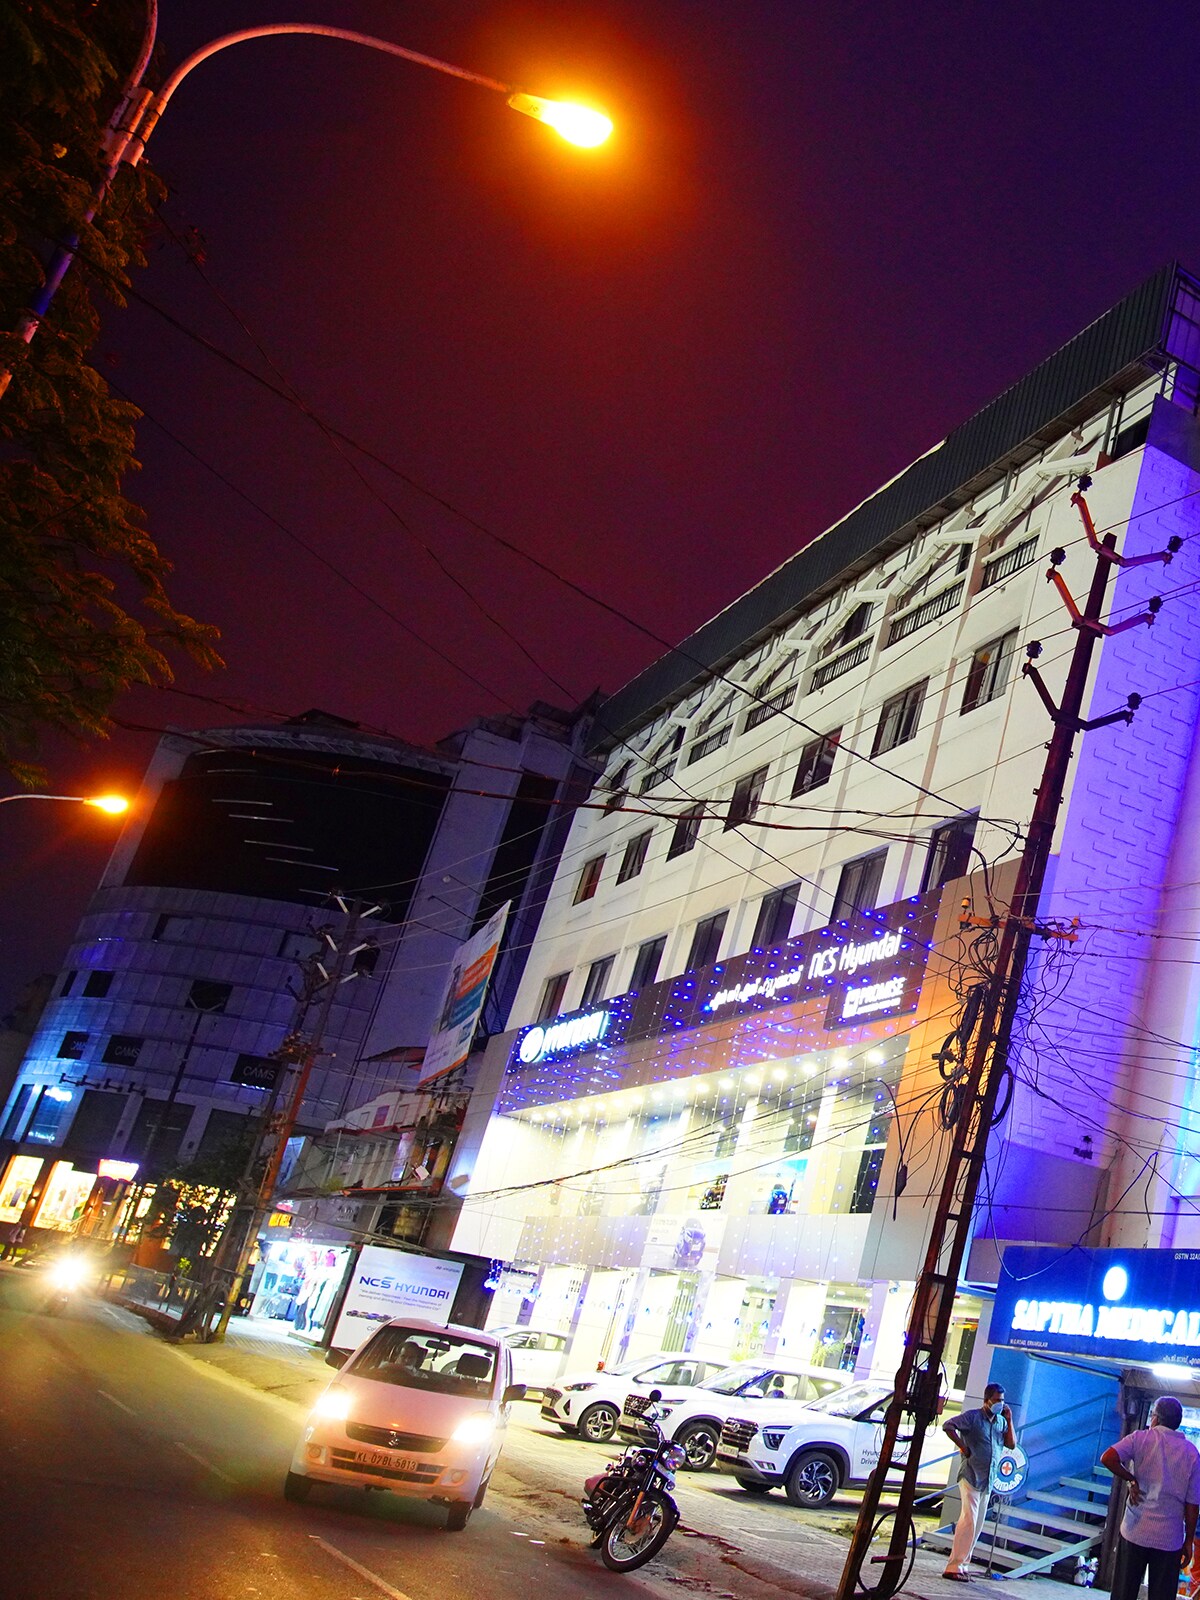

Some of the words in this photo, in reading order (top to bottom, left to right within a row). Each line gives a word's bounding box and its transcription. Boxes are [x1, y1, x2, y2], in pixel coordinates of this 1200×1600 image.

[808, 946, 841, 980] NCS
[838, 926, 904, 975] Hyundai
[243, 1065, 276, 1081] CAMS
[359, 1275, 395, 1289] NCS
[394, 1282, 450, 1300] HYUNDAI
[1011, 1299, 1094, 1337] SAPTHA
